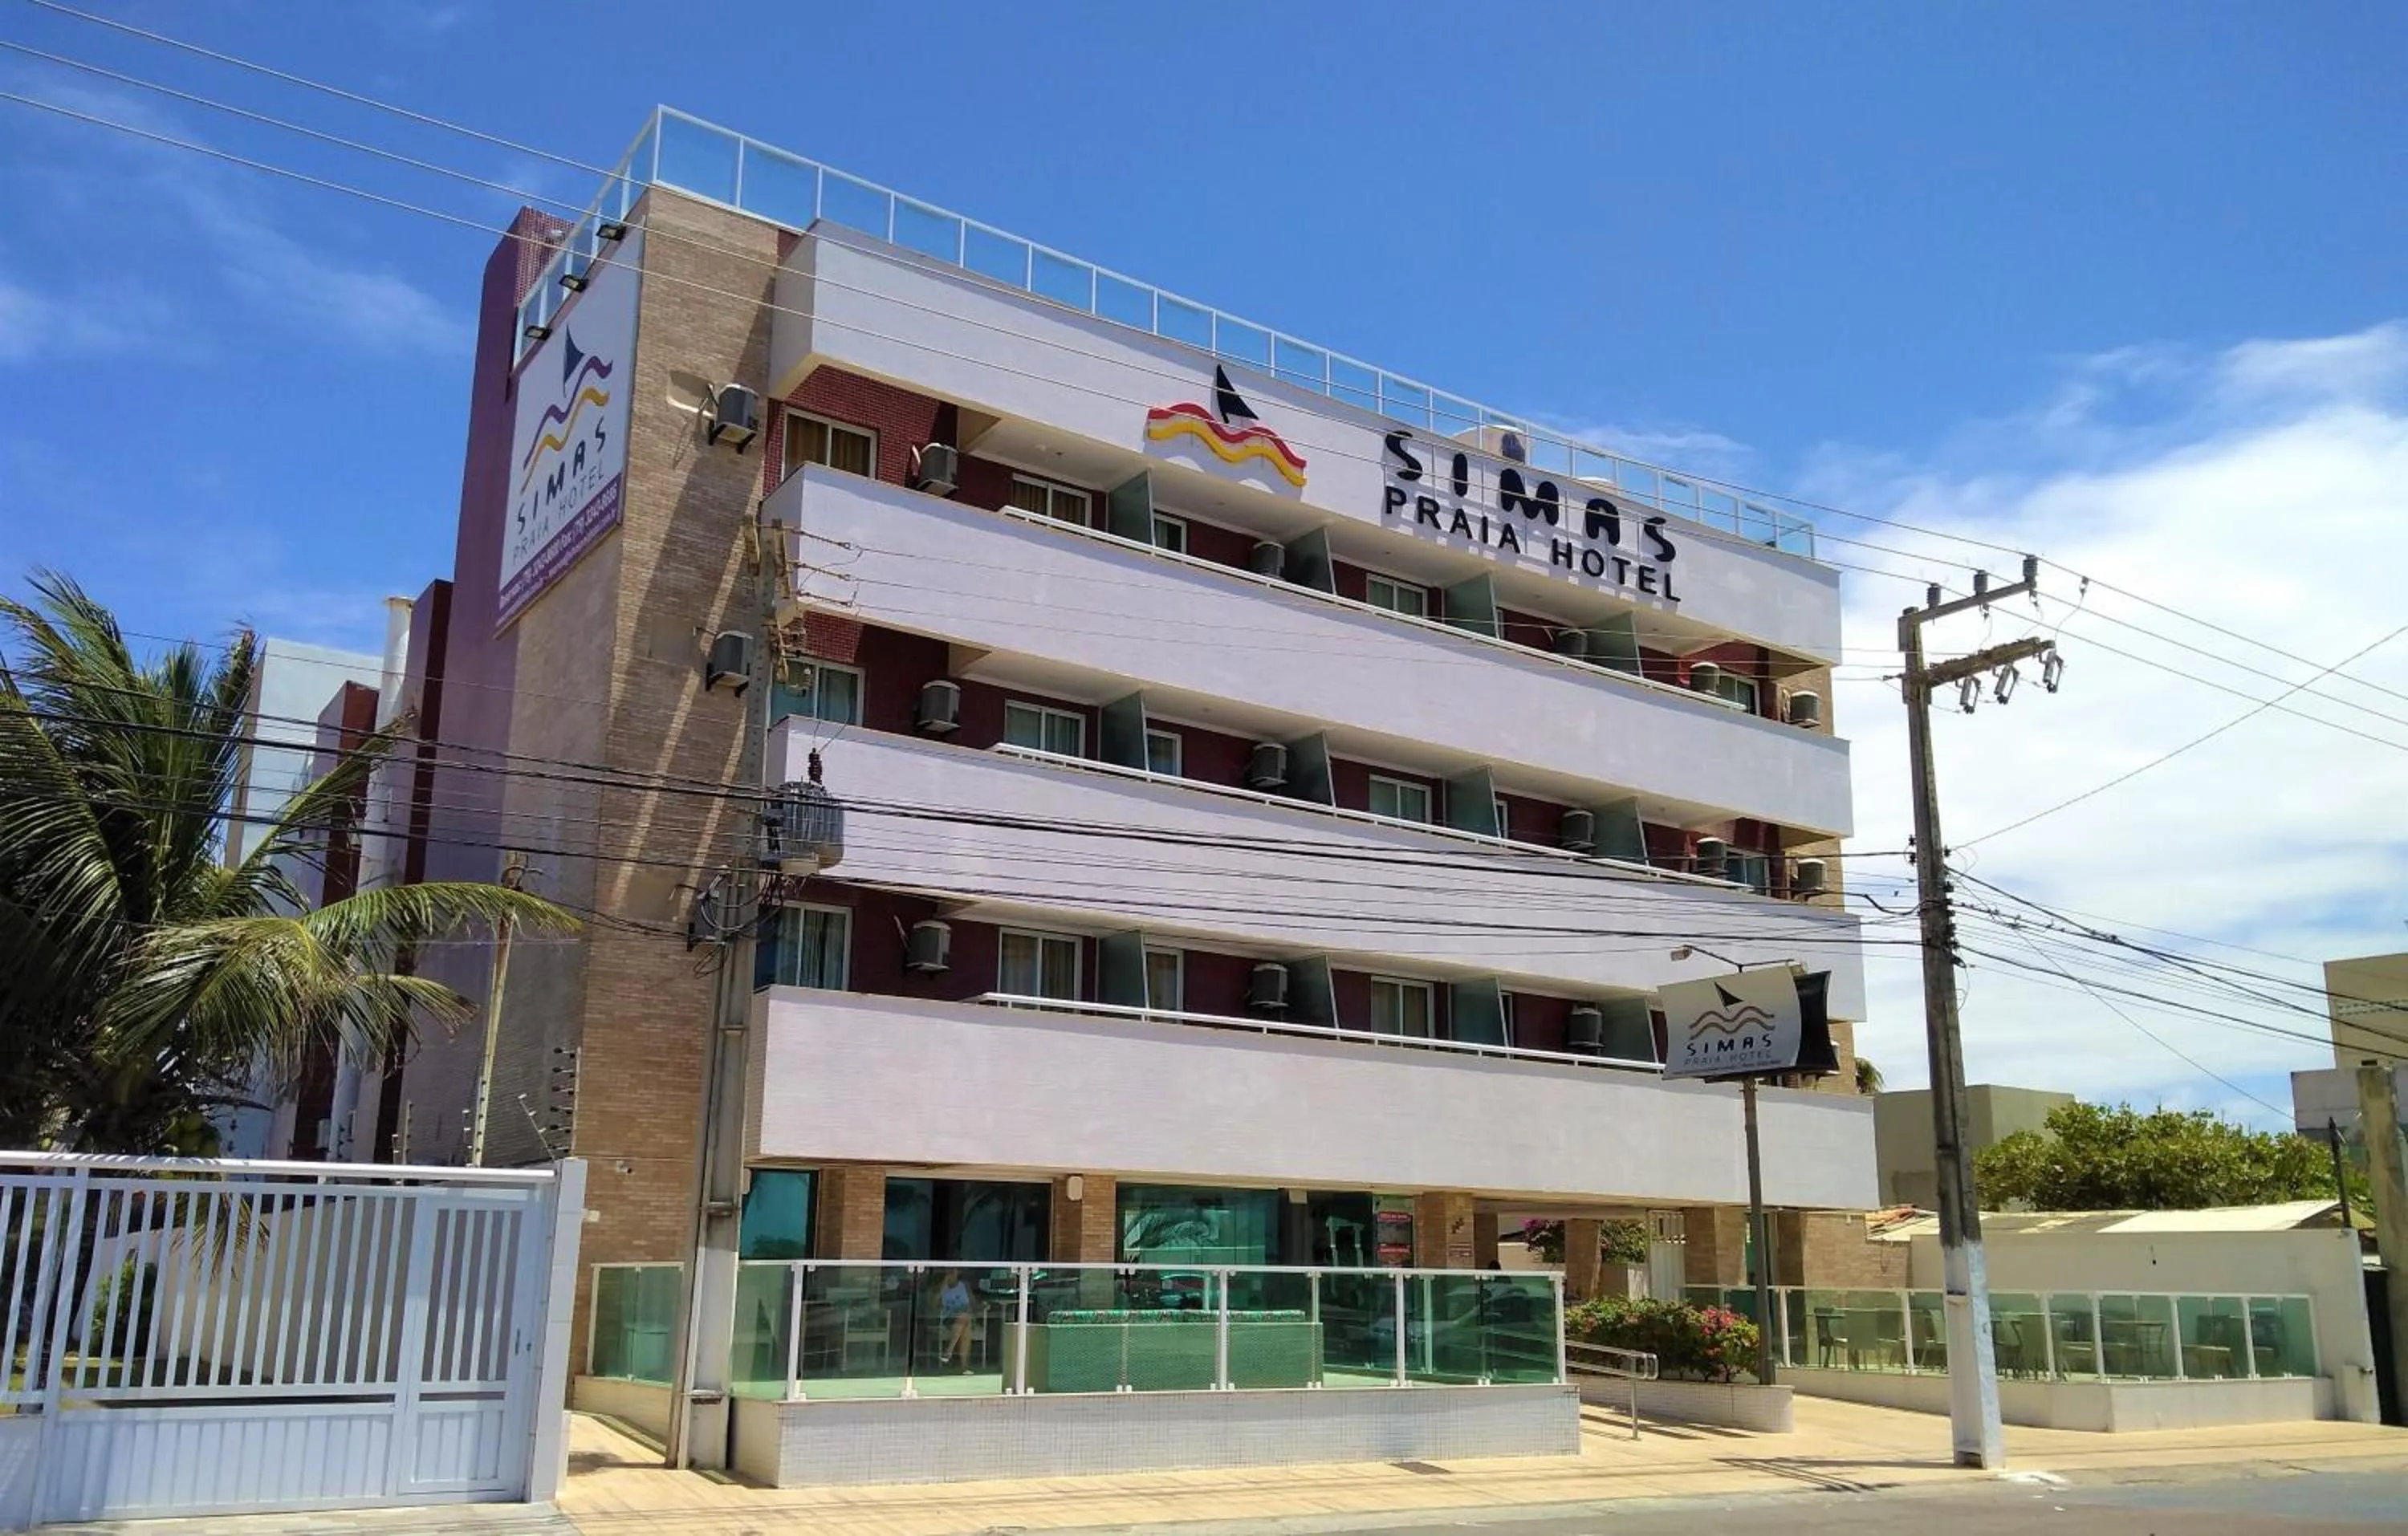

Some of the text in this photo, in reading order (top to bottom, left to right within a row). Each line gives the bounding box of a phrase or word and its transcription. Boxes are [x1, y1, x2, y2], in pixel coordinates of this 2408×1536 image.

[512, 461, 604, 567] PRAIA HOTEL
[517, 414, 606, 535] SIMAS
[1385, 430, 1677, 563] SIMAS
[1385, 485, 1682, 603] PRAIA HOTEL
[1684, 1055, 1721, 1067] PRAIA
[1729, 1049, 1772, 1063] HOTEL
[1686, 1033, 1772, 1057] SIMAS
